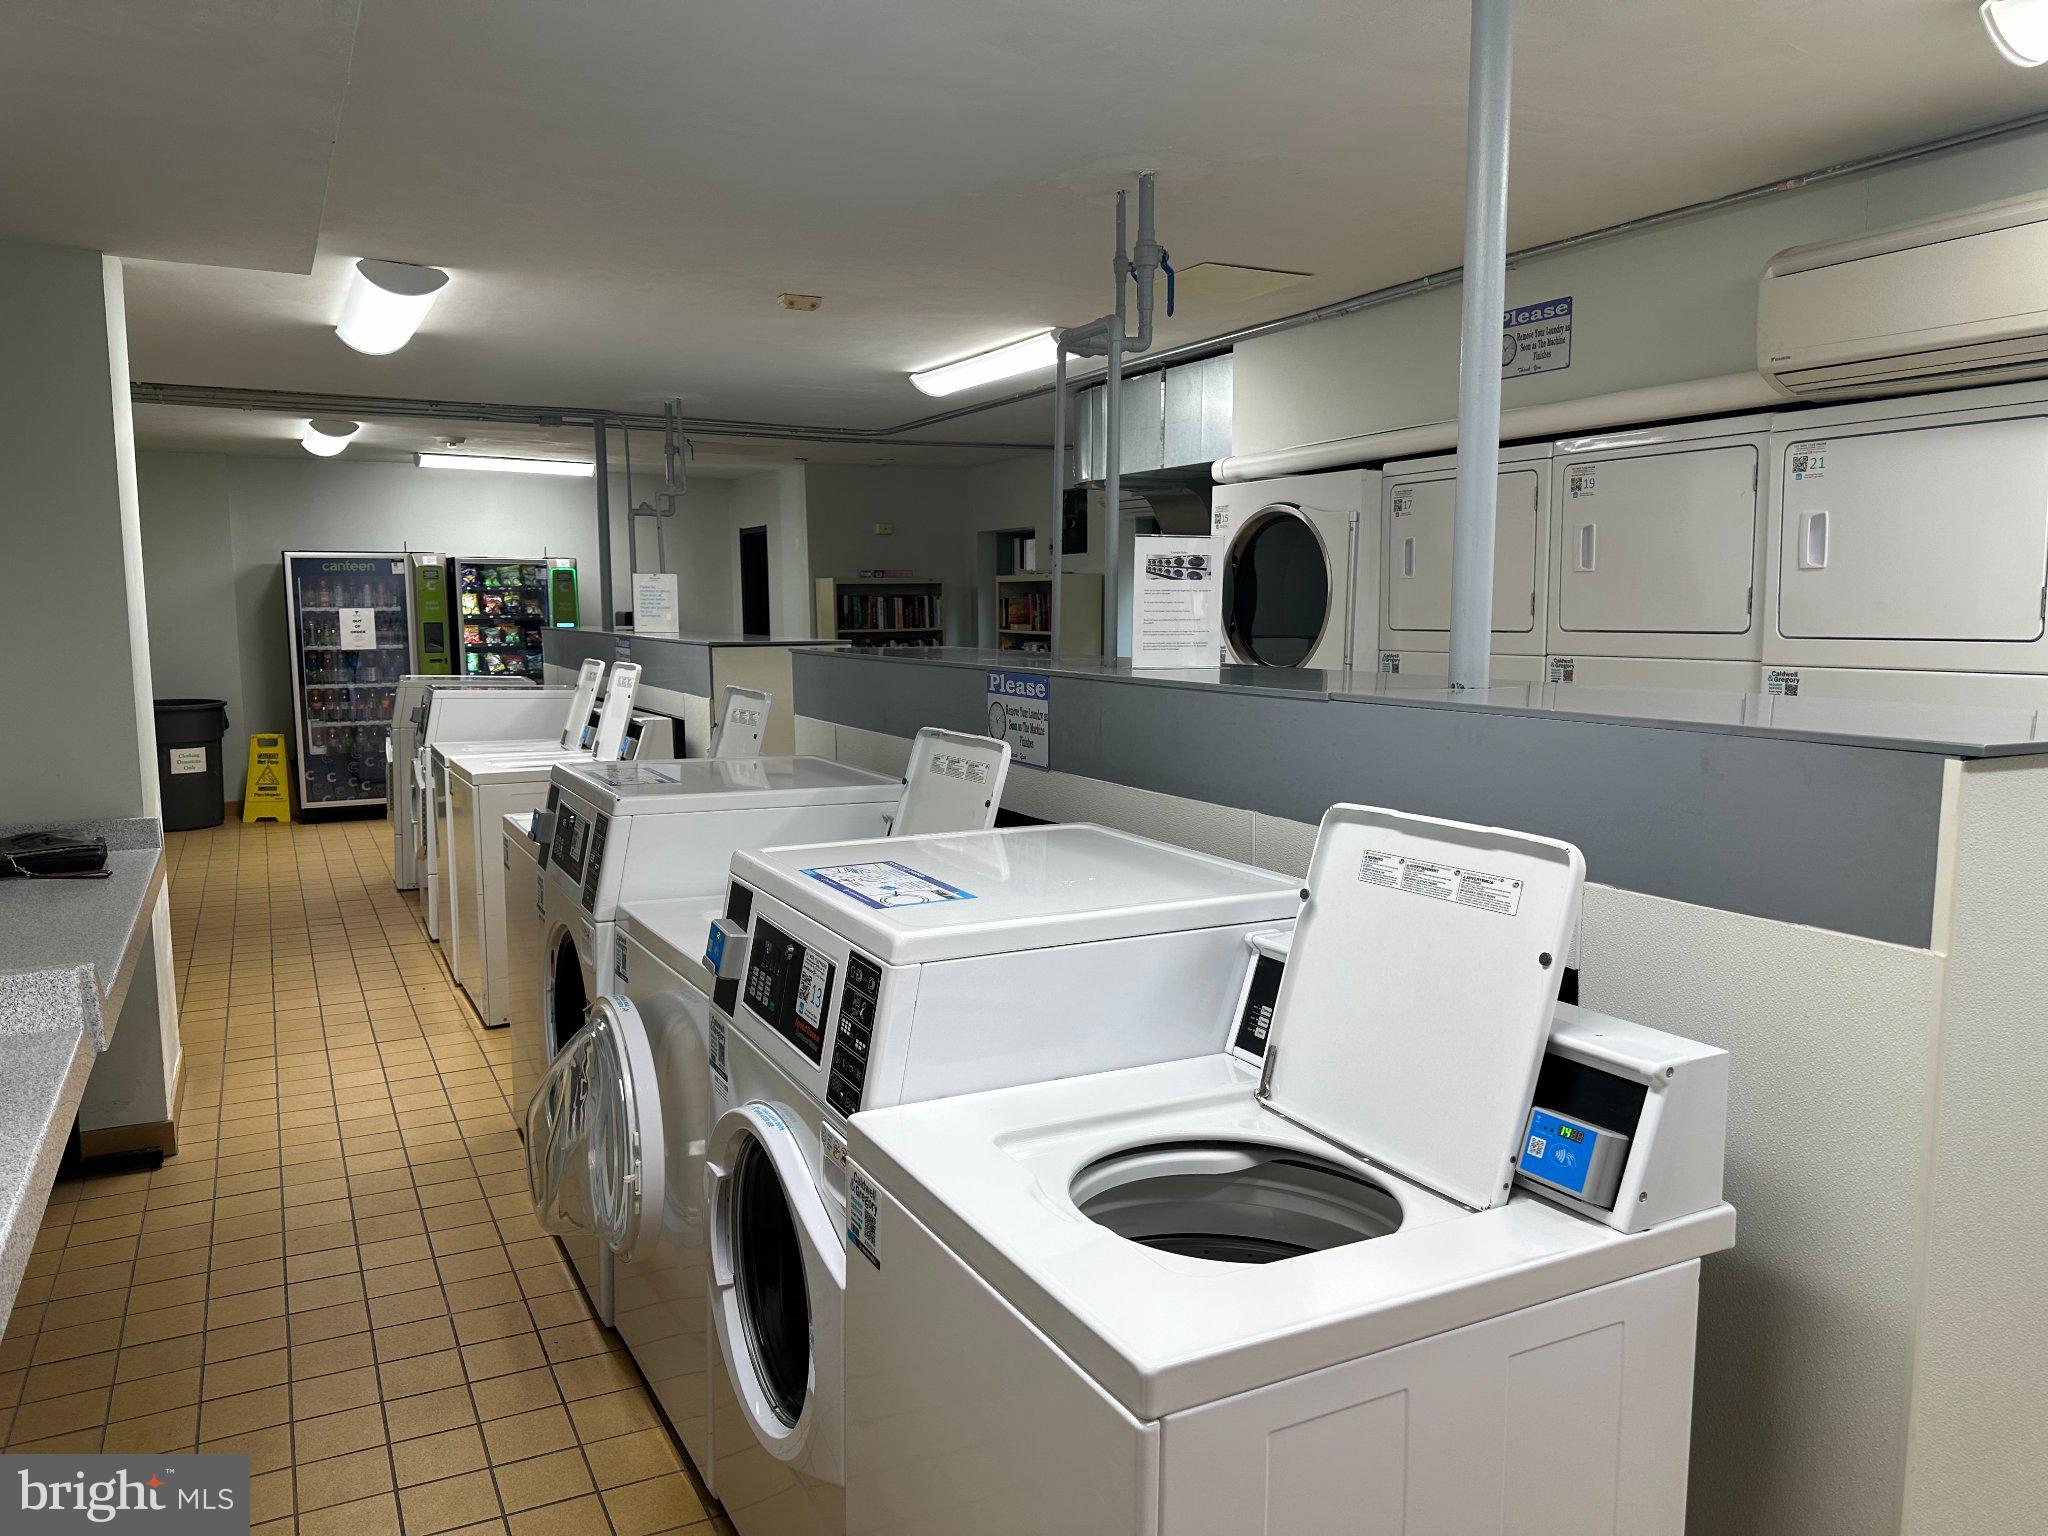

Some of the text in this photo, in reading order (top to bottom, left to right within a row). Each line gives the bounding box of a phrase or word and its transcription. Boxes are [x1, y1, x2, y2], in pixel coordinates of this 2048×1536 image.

[1517, 331, 1534, 342] Remove
[1535, 328, 1546, 338] Your
[1546, 324, 1565, 336] Laundry
[1520, 343, 1531, 352] Soon
[1538, 339, 1546, 349] The
[1547, 336, 1566, 347] Machine
[1533, 351, 1552, 360] Finishes
[1810, 456, 1825, 470] 21
[1584, 477, 1595, 489] 19
[1403, 499, 1412, 510] 17
[1221, 513, 1229, 523] 15
[321, 561, 375, 572] canteen
[989, 673, 1046, 698] Please
[810, 984, 822, 1009] 13
[853, 1171, 877, 1201] Caldwell
[855, 1185, 878, 1217] Gregory
